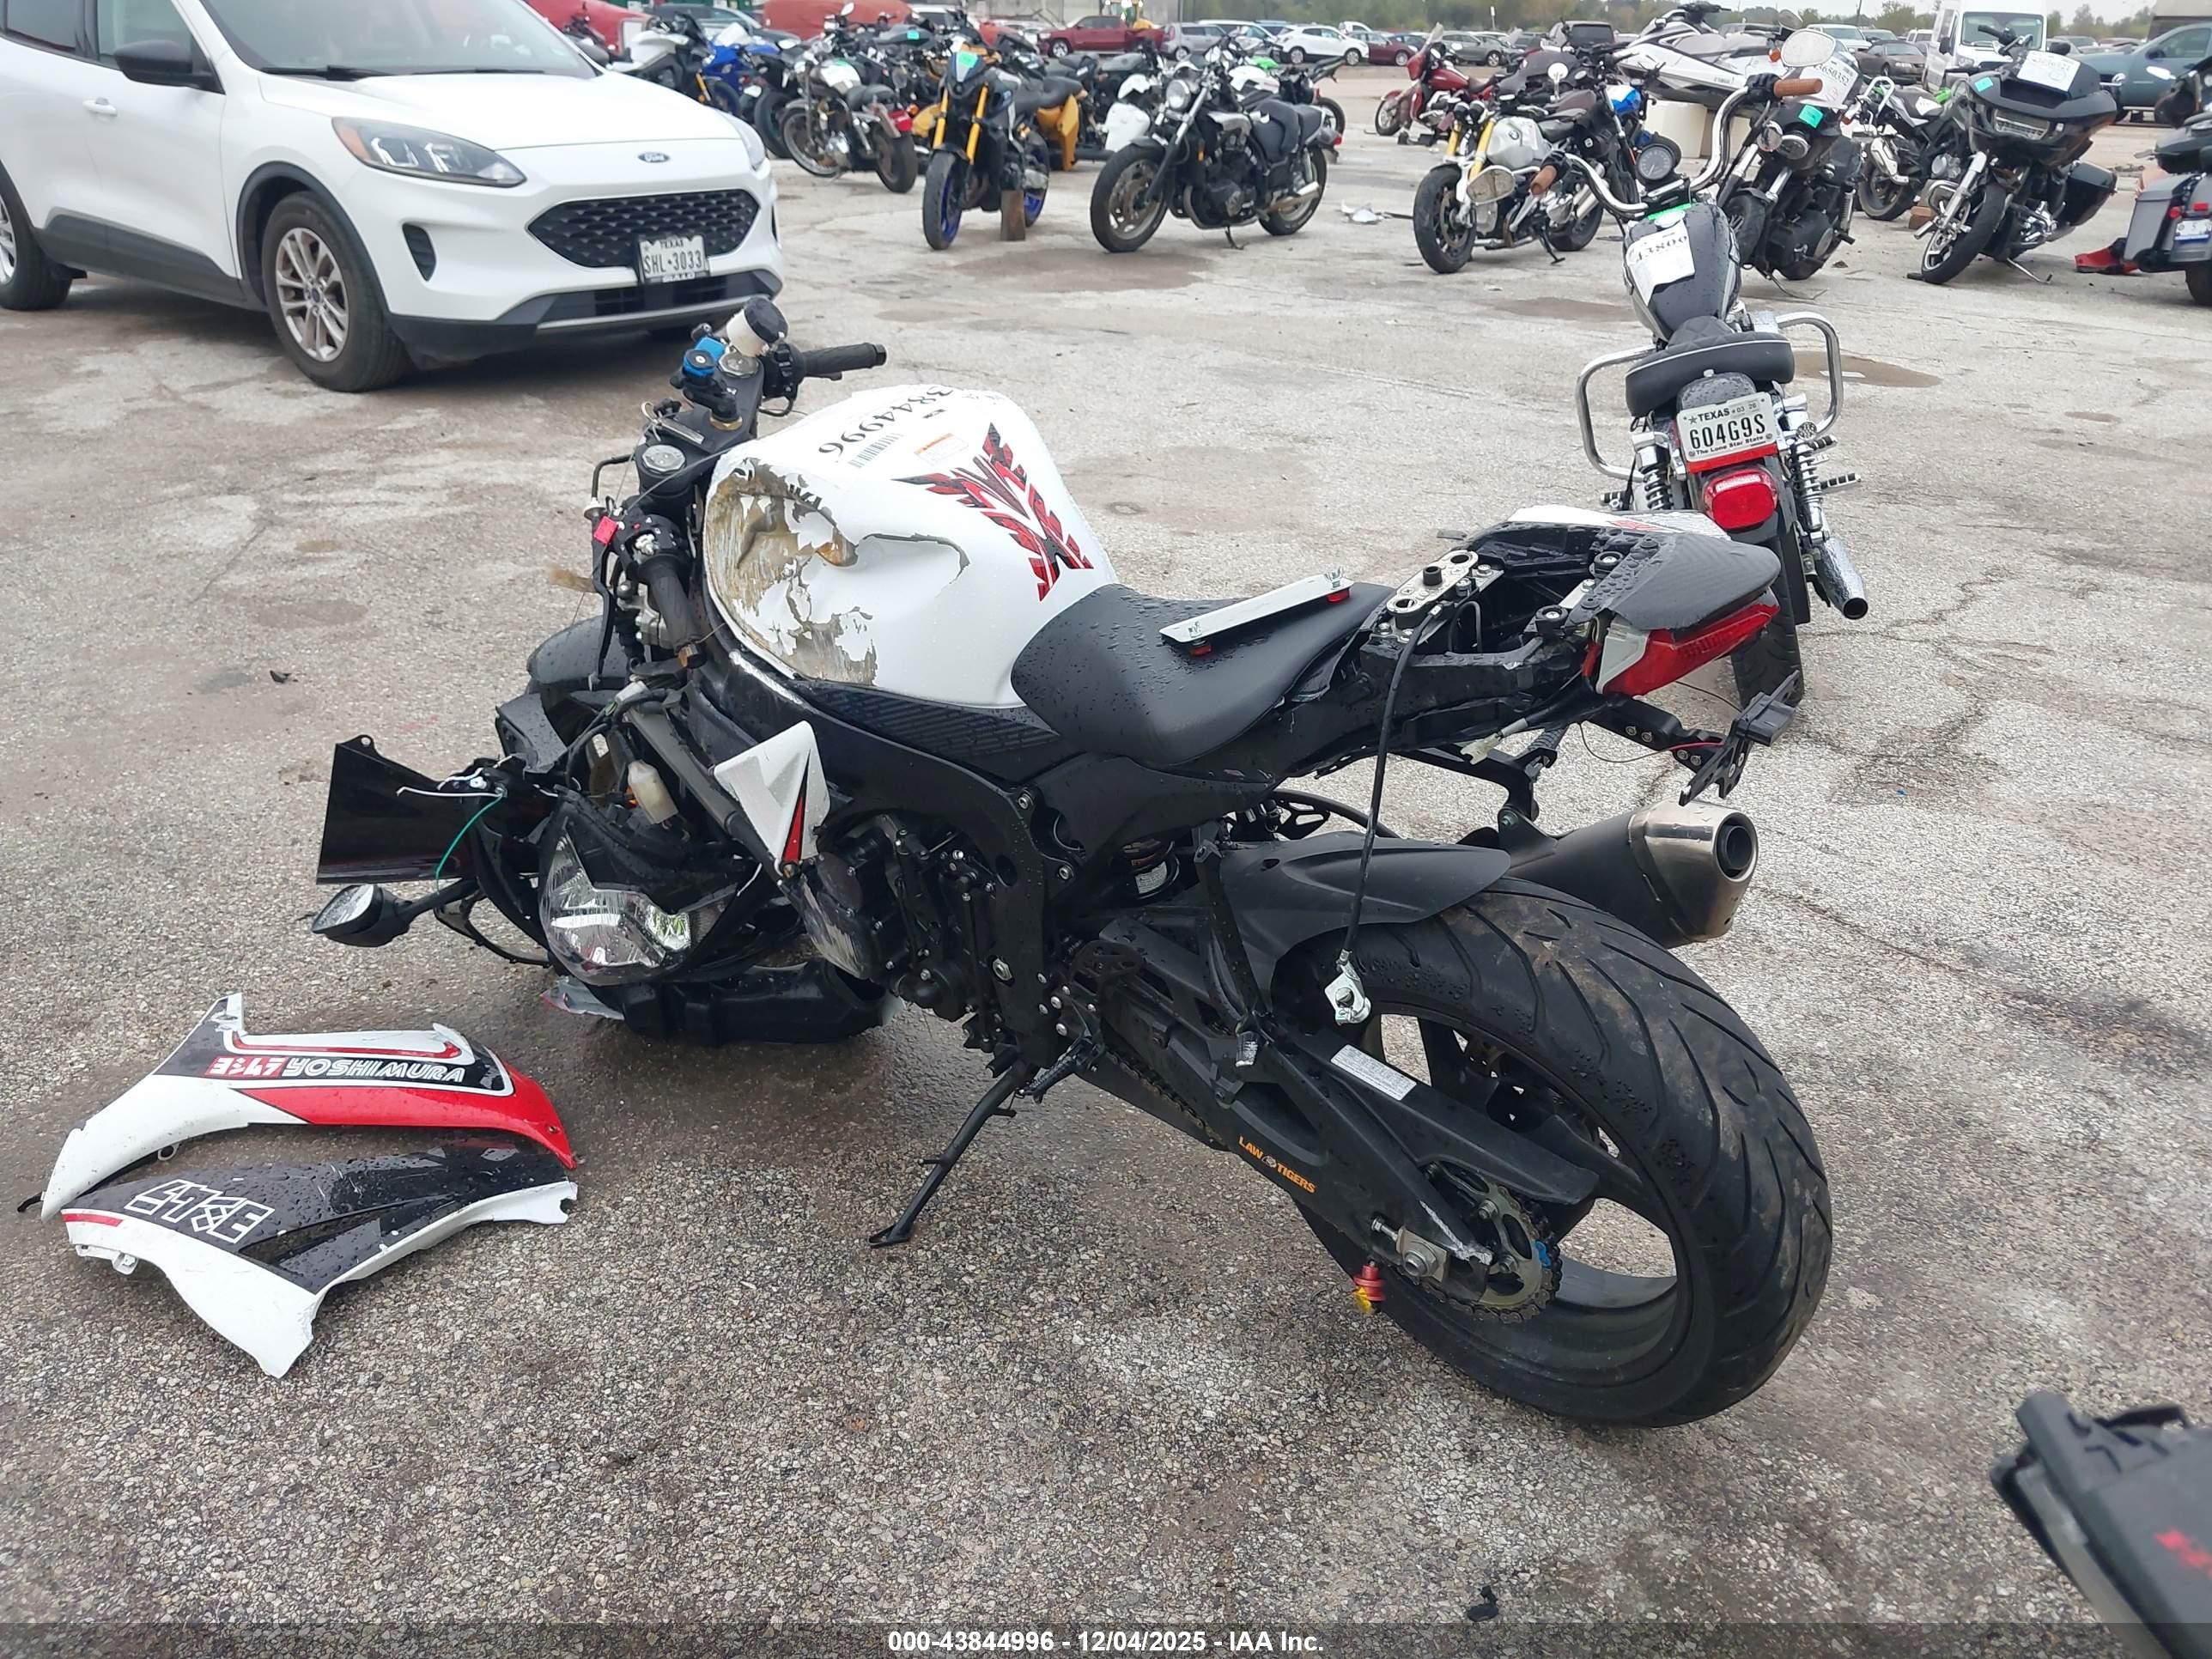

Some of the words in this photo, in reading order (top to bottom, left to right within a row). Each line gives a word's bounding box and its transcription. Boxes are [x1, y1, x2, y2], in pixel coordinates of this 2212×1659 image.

[1698, 408, 1730, 422] TEXAS
[1689, 414, 1765, 449] 604G9S
[1711, 443, 1727, 453] Lone
[1745, 435, 1764, 444] State
[282, 1057, 466, 1083] YOSHIMURA
[1237, 1135, 1263, 1159] LAW
[1276, 1161, 1316, 1194] TIGERS
